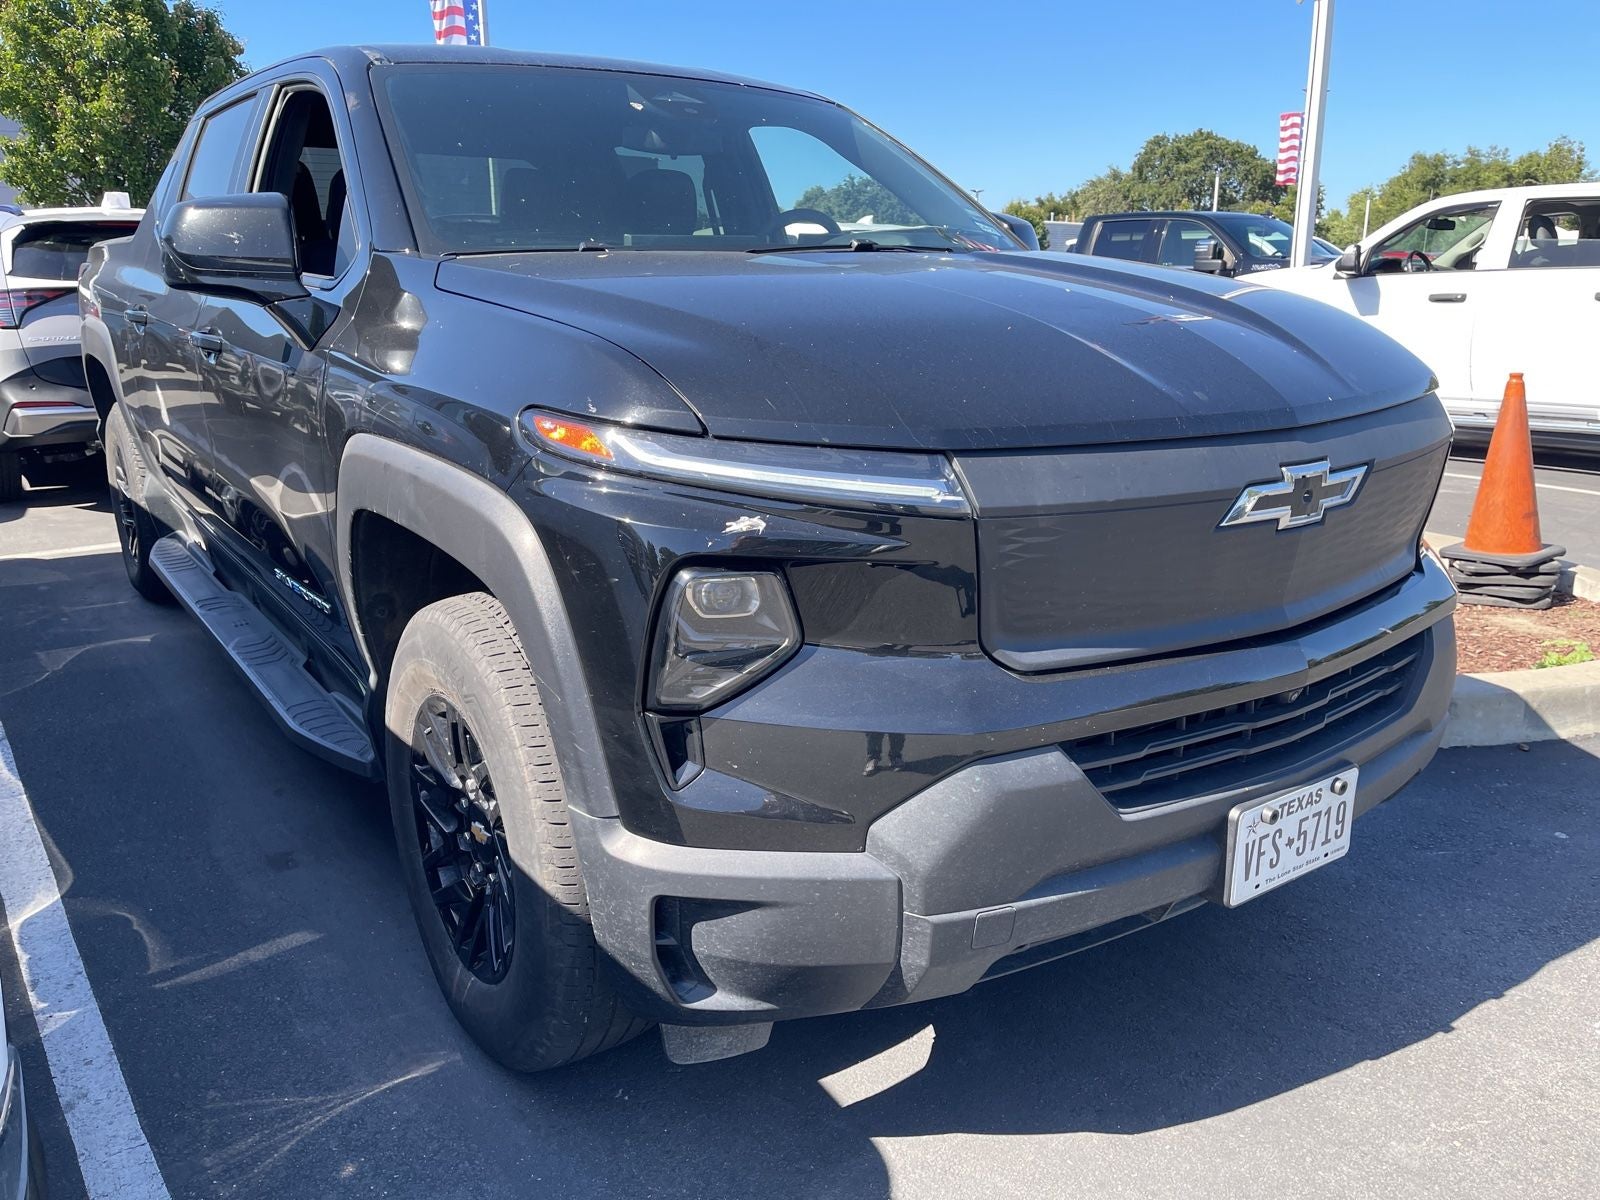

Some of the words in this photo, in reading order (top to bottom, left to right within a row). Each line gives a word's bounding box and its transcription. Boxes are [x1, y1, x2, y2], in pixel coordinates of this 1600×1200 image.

[1278, 787, 1323, 820] TEXAS
[1244, 827, 1283, 882] VFS
[1295, 800, 1347, 857] 5719
[1265, 876, 1276, 885] The
[1277, 869, 1291, 879] Lone
[1292, 862, 1304, 872] Star
[1306, 856, 1320, 866] State
